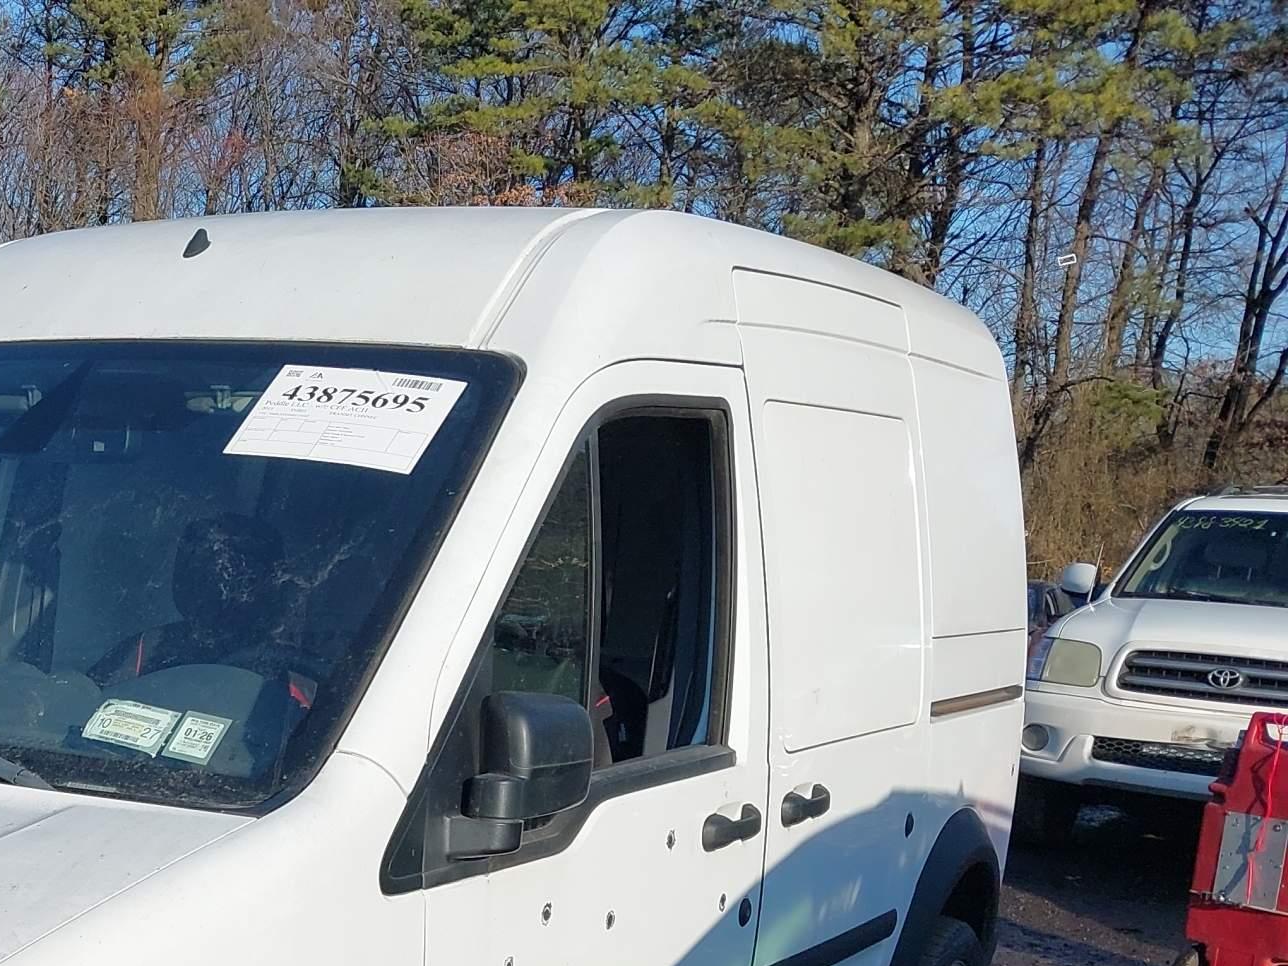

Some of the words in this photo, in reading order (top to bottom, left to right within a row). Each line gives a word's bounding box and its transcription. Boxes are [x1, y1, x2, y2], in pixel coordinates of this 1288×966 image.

[282, 384, 432, 414] 43875695
[98, 717, 112, 729] 10
[140, 727, 162, 740] 27
